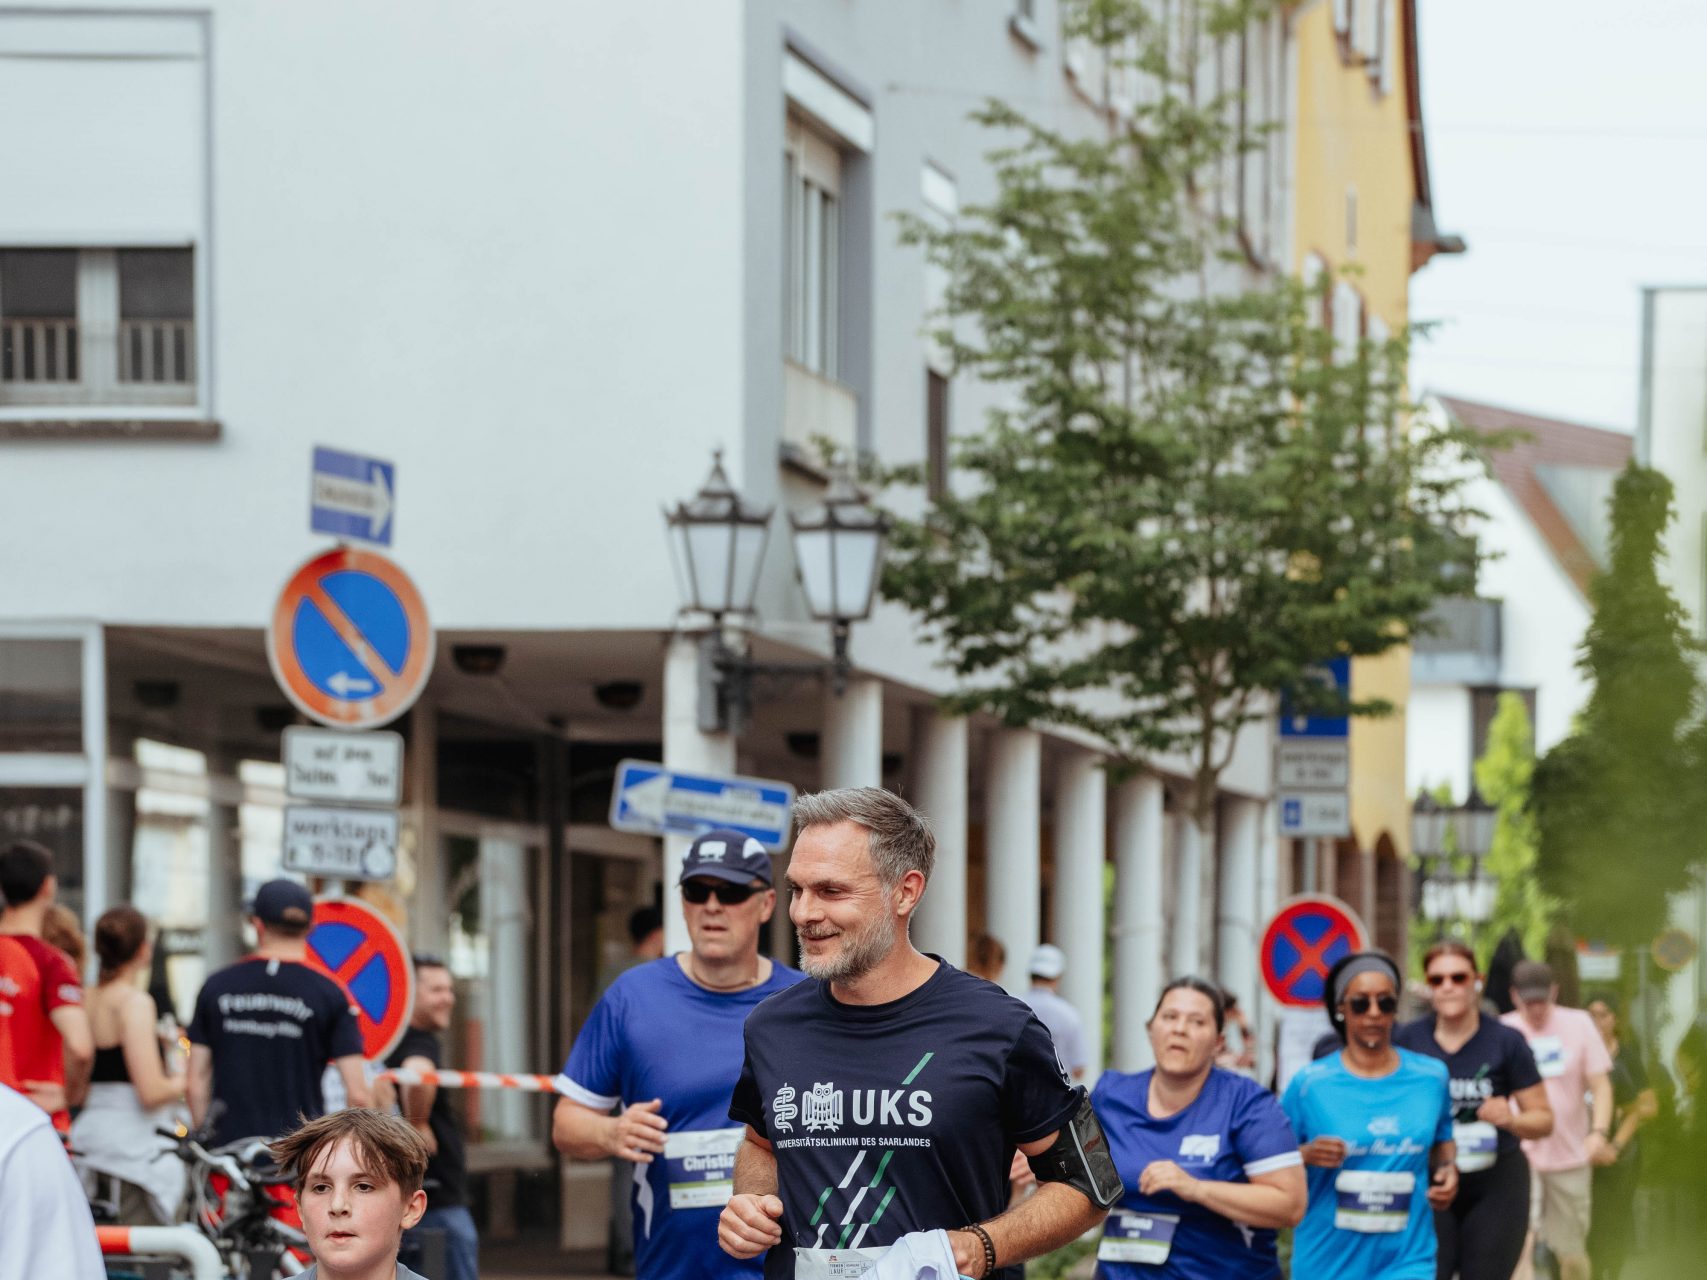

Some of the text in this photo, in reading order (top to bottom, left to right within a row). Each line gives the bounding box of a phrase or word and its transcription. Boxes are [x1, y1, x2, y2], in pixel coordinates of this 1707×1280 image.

[1449, 1078, 1493, 1100] UKS
[852, 1089, 933, 1127] UKS
[776, 1136, 931, 1149] UNIVERSITÄTSKLINIKUM DES SAARLANDES
